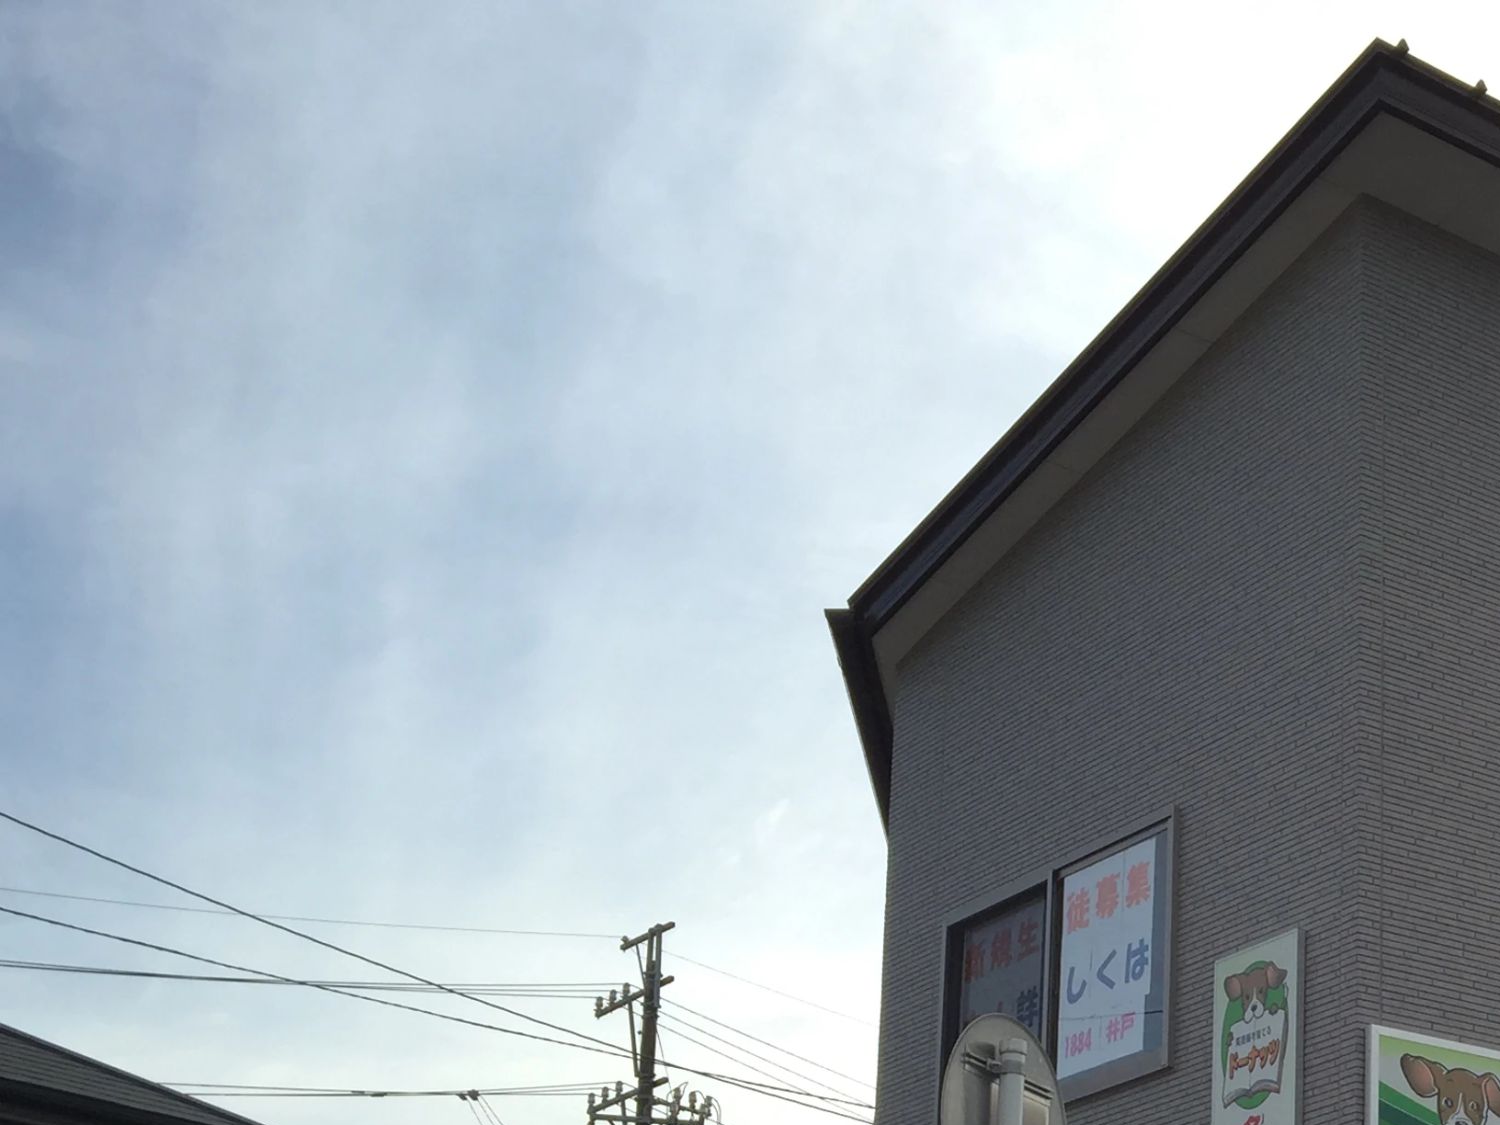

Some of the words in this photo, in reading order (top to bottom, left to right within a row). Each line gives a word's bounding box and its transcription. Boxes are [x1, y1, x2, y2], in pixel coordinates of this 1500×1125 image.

[1066, 938, 1149, 1005] しくは
[1064, 1028, 1092, 1059] 1884
